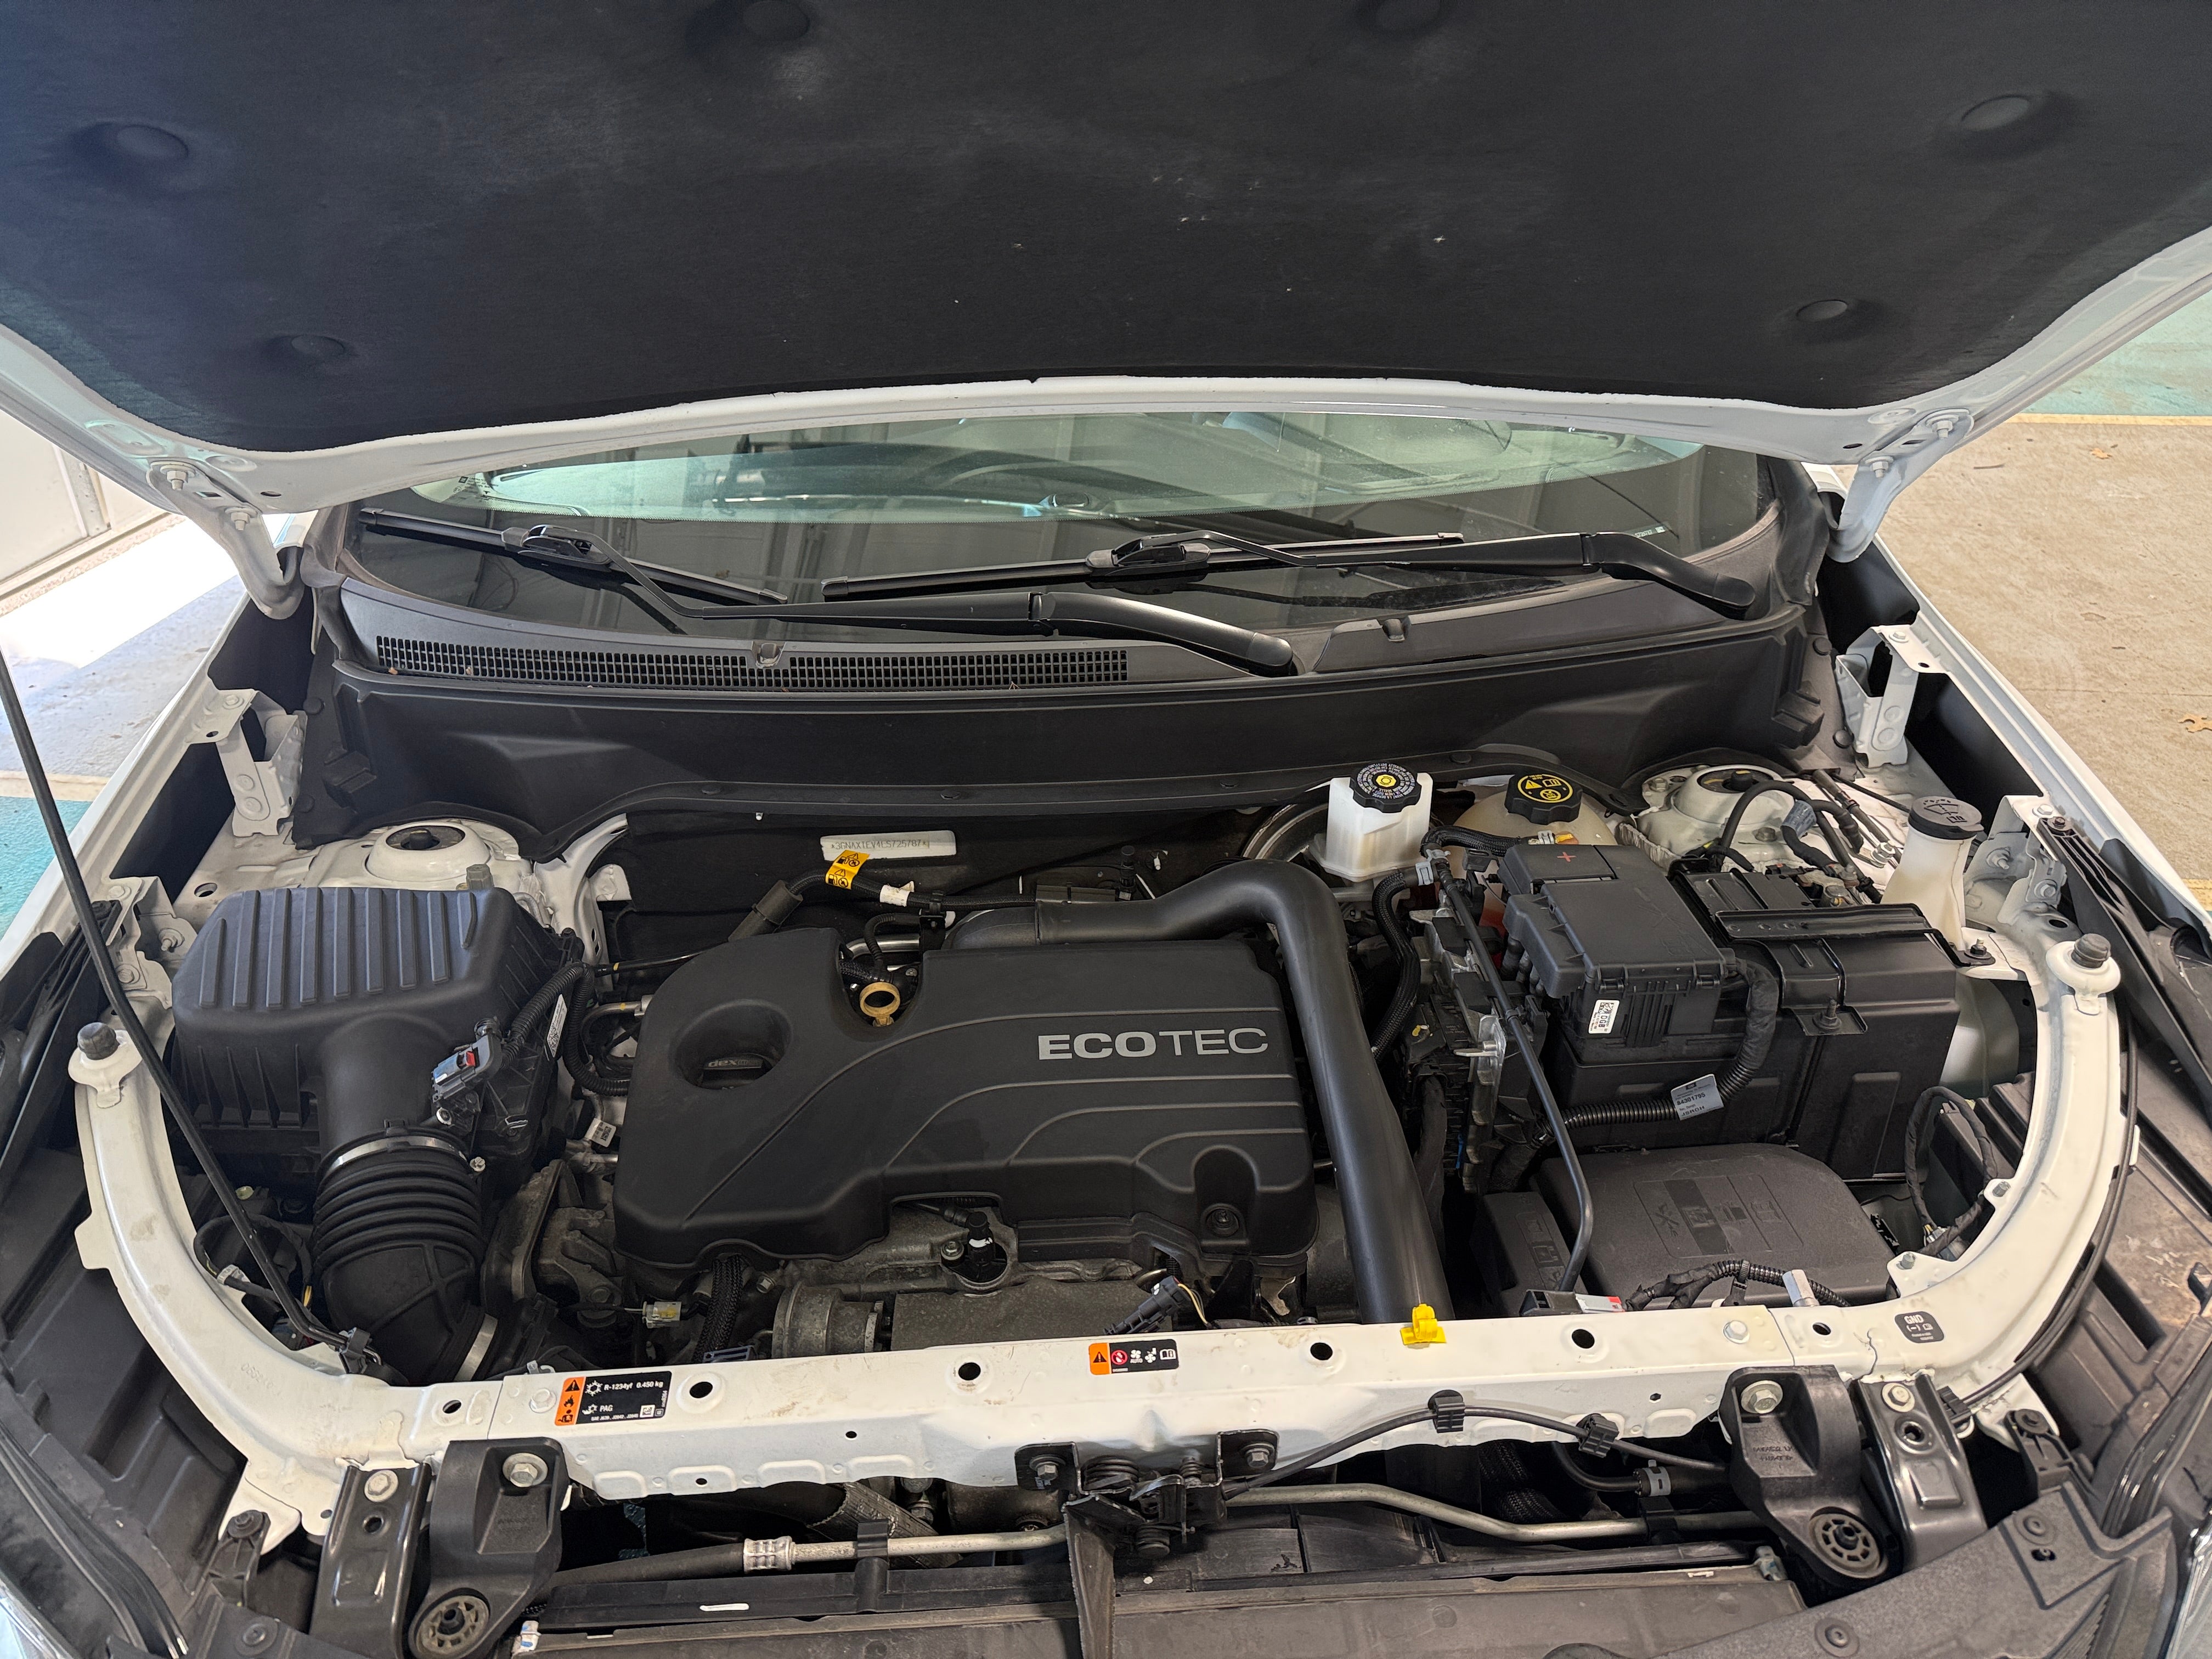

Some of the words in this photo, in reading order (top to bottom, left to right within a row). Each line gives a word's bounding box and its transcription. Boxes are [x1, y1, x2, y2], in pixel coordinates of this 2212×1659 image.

[1038, 1027, 1268, 1060] ECOTEC
[1904, 1314, 1924, 1324] GND
[603, 1383, 633, 1391] R-1234yf
